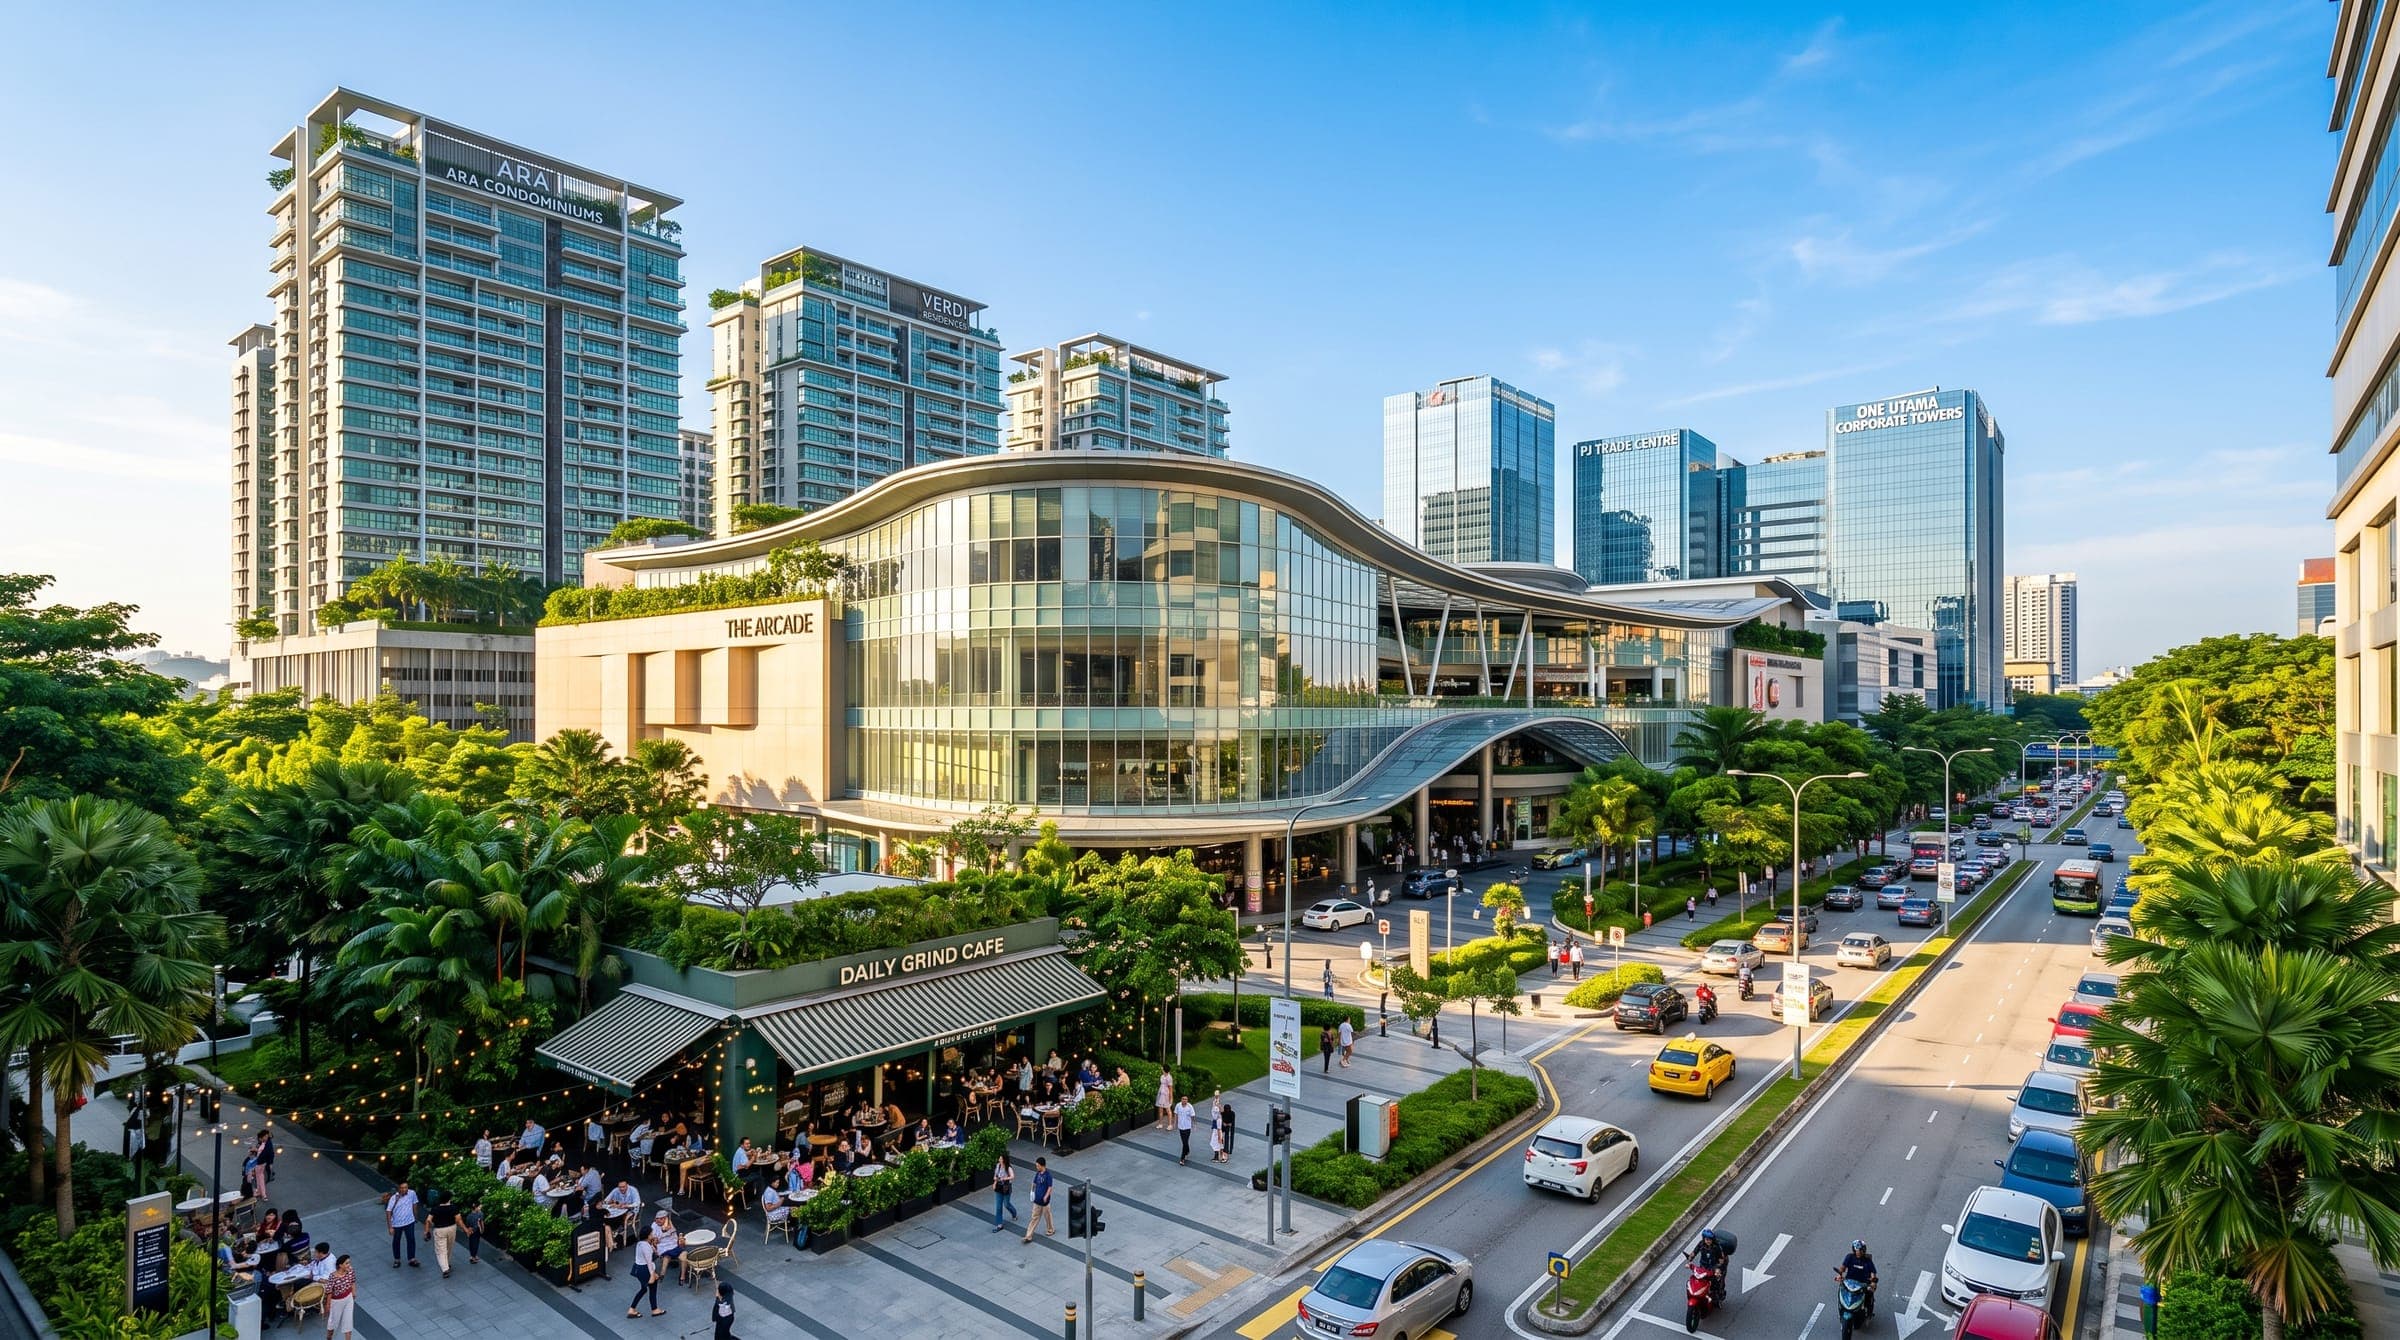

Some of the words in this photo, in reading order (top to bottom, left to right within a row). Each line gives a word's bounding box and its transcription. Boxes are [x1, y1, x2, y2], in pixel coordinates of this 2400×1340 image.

[497, 159, 549, 191] ARA
[446, 167, 479, 188] ARA
[484, 178, 604, 224] CONDOMINIUMS
[922, 291, 968, 320] VERDI
[922, 310, 968, 331] RESIDENCES
[1835, 415, 1908, 434] CORPORATE
[1910, 406, 1964, 425] TOWERS
[1856, 404, 1886, 419] ONE
[1889, 396, 1939, 414] UTAMA
[1580, 445, 1593, 457] PJ
[1595, 440, 1633, 455] TRADE
[1634, 433, 1679, 450] CENTRE
[725, 618, 753, 638] THE
[754, 613, 814, 637] ARCADE
[840, 957, 897, 986] DAILY
[901, 946, 958, 973] GRIND
[961, 937, 1005, 960] CAFE
